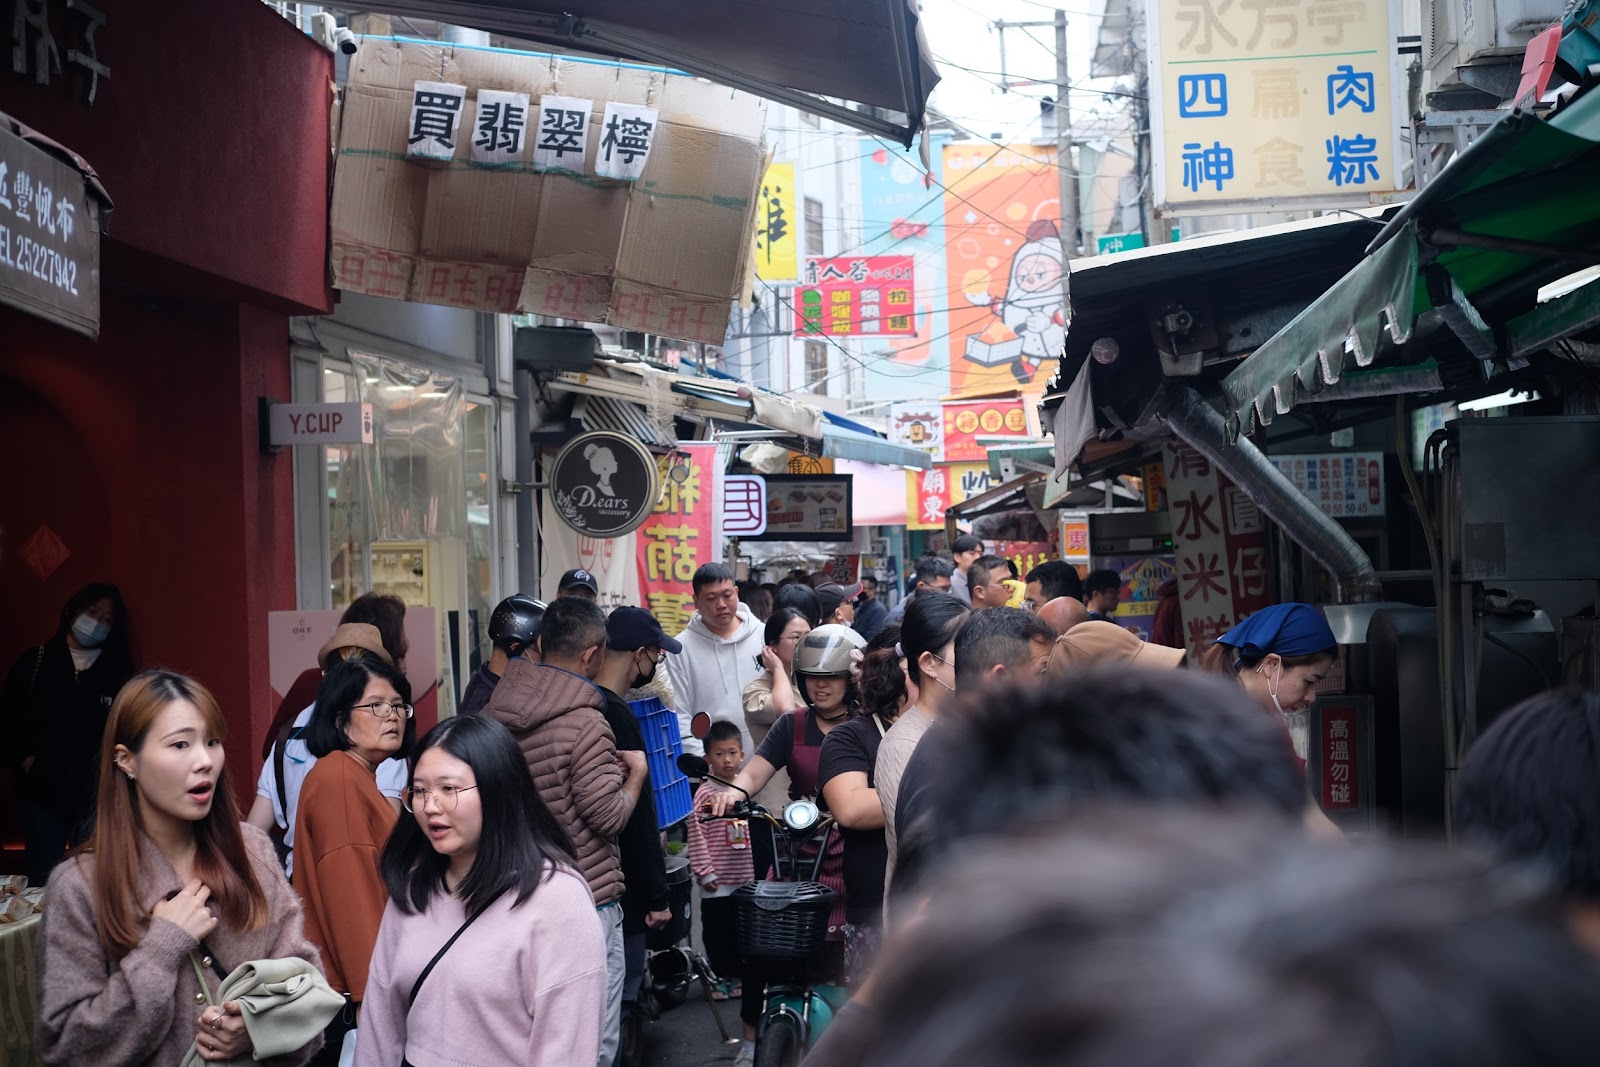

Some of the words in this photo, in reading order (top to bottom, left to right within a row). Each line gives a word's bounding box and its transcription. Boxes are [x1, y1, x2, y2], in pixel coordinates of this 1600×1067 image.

[407, 90, 654, 165] 買翡翠檸
[1178, 73, 1235, 192] 四神
[1250, 67, 1306, 188] 扁食
[1326, 65, 1380, 187] 肉粽
[16, 234, 78, 296] 25227942
[289, 412, 343, 435] Y.CUP
[571, 485, 629, 509] D.ears
[922, 468, 946, 522] 廟東
[1224, 486, 1268, 622] 圓仔
[1329, 719, 1351, 803] 高溫勿碰
